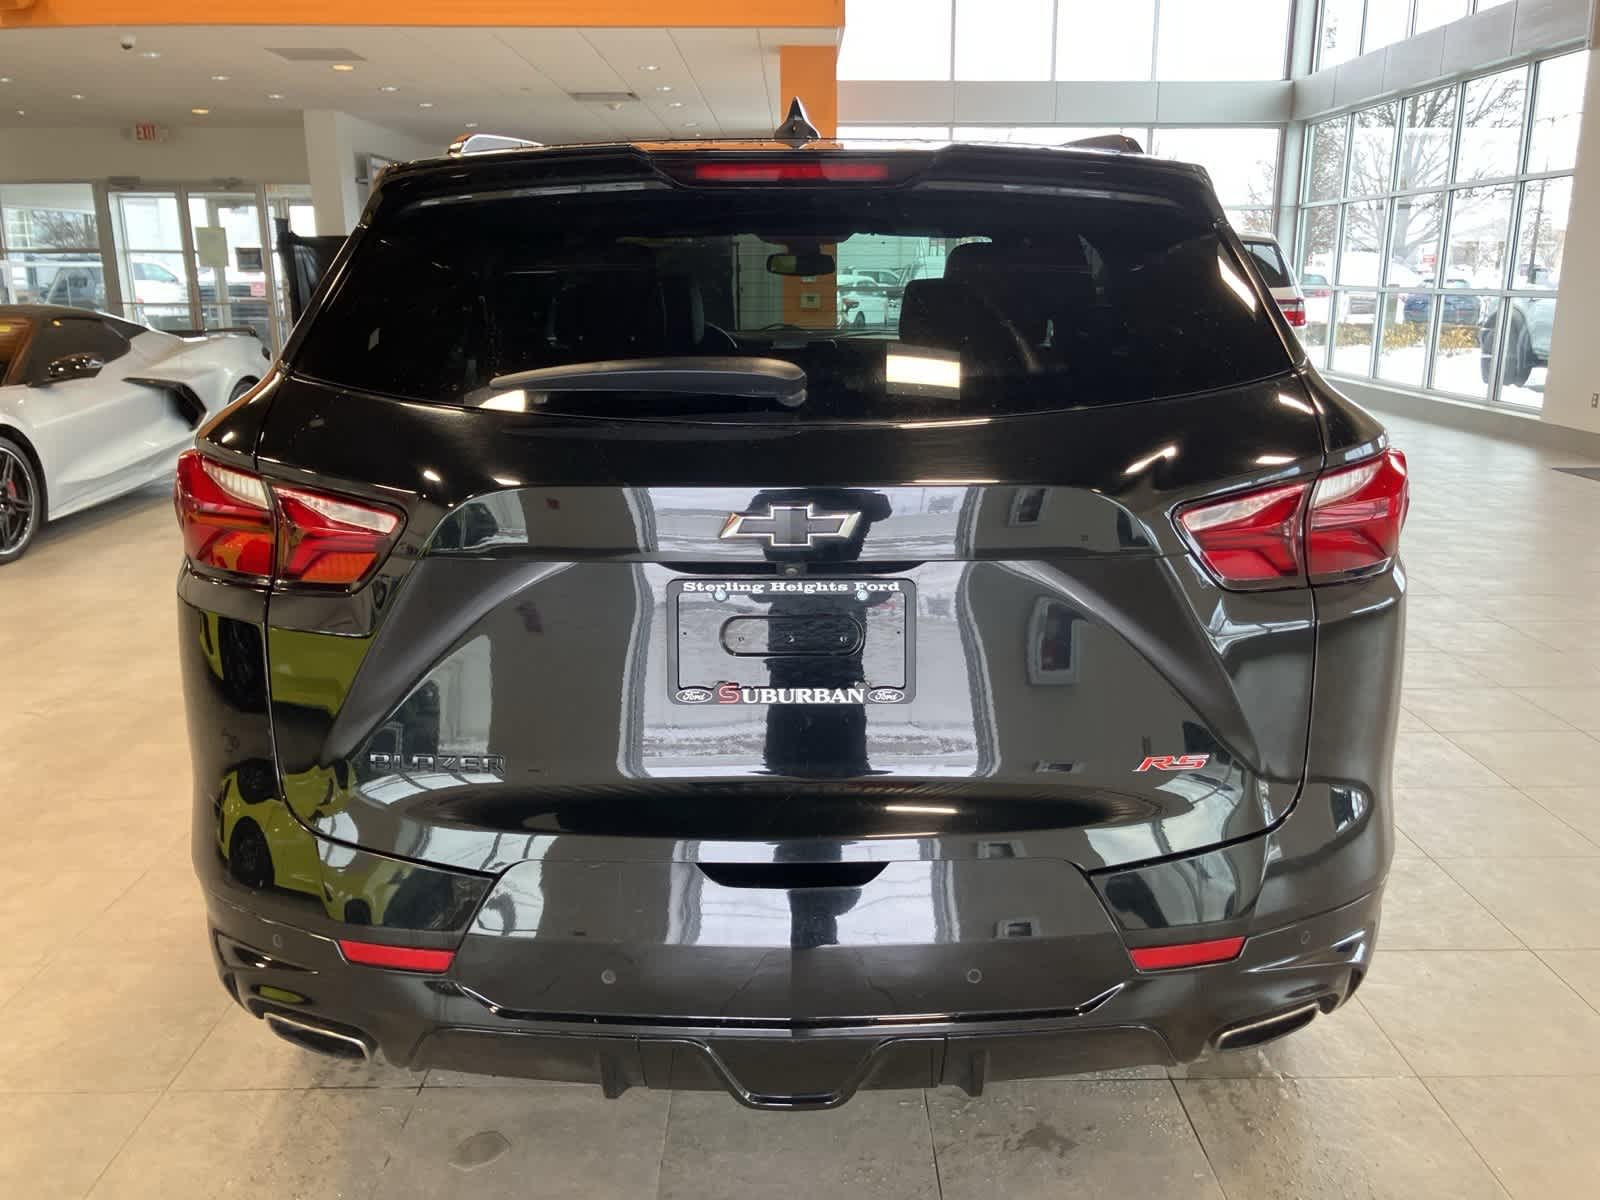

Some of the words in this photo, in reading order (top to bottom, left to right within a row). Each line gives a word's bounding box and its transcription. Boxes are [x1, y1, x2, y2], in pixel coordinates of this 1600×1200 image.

[683, 582, 765, 593] Sterling
[769, 582, 848, 593] Heights
[854, 582, 899, 592] Ford
[682, 692, 705, 701] Ford
[718, 685, 865, 704] SUBURBAN
[874, 692, 897, 701] Ford
[369, 754, 505, 773] BLAZER
[1132, 754, 1210, 772] RS
